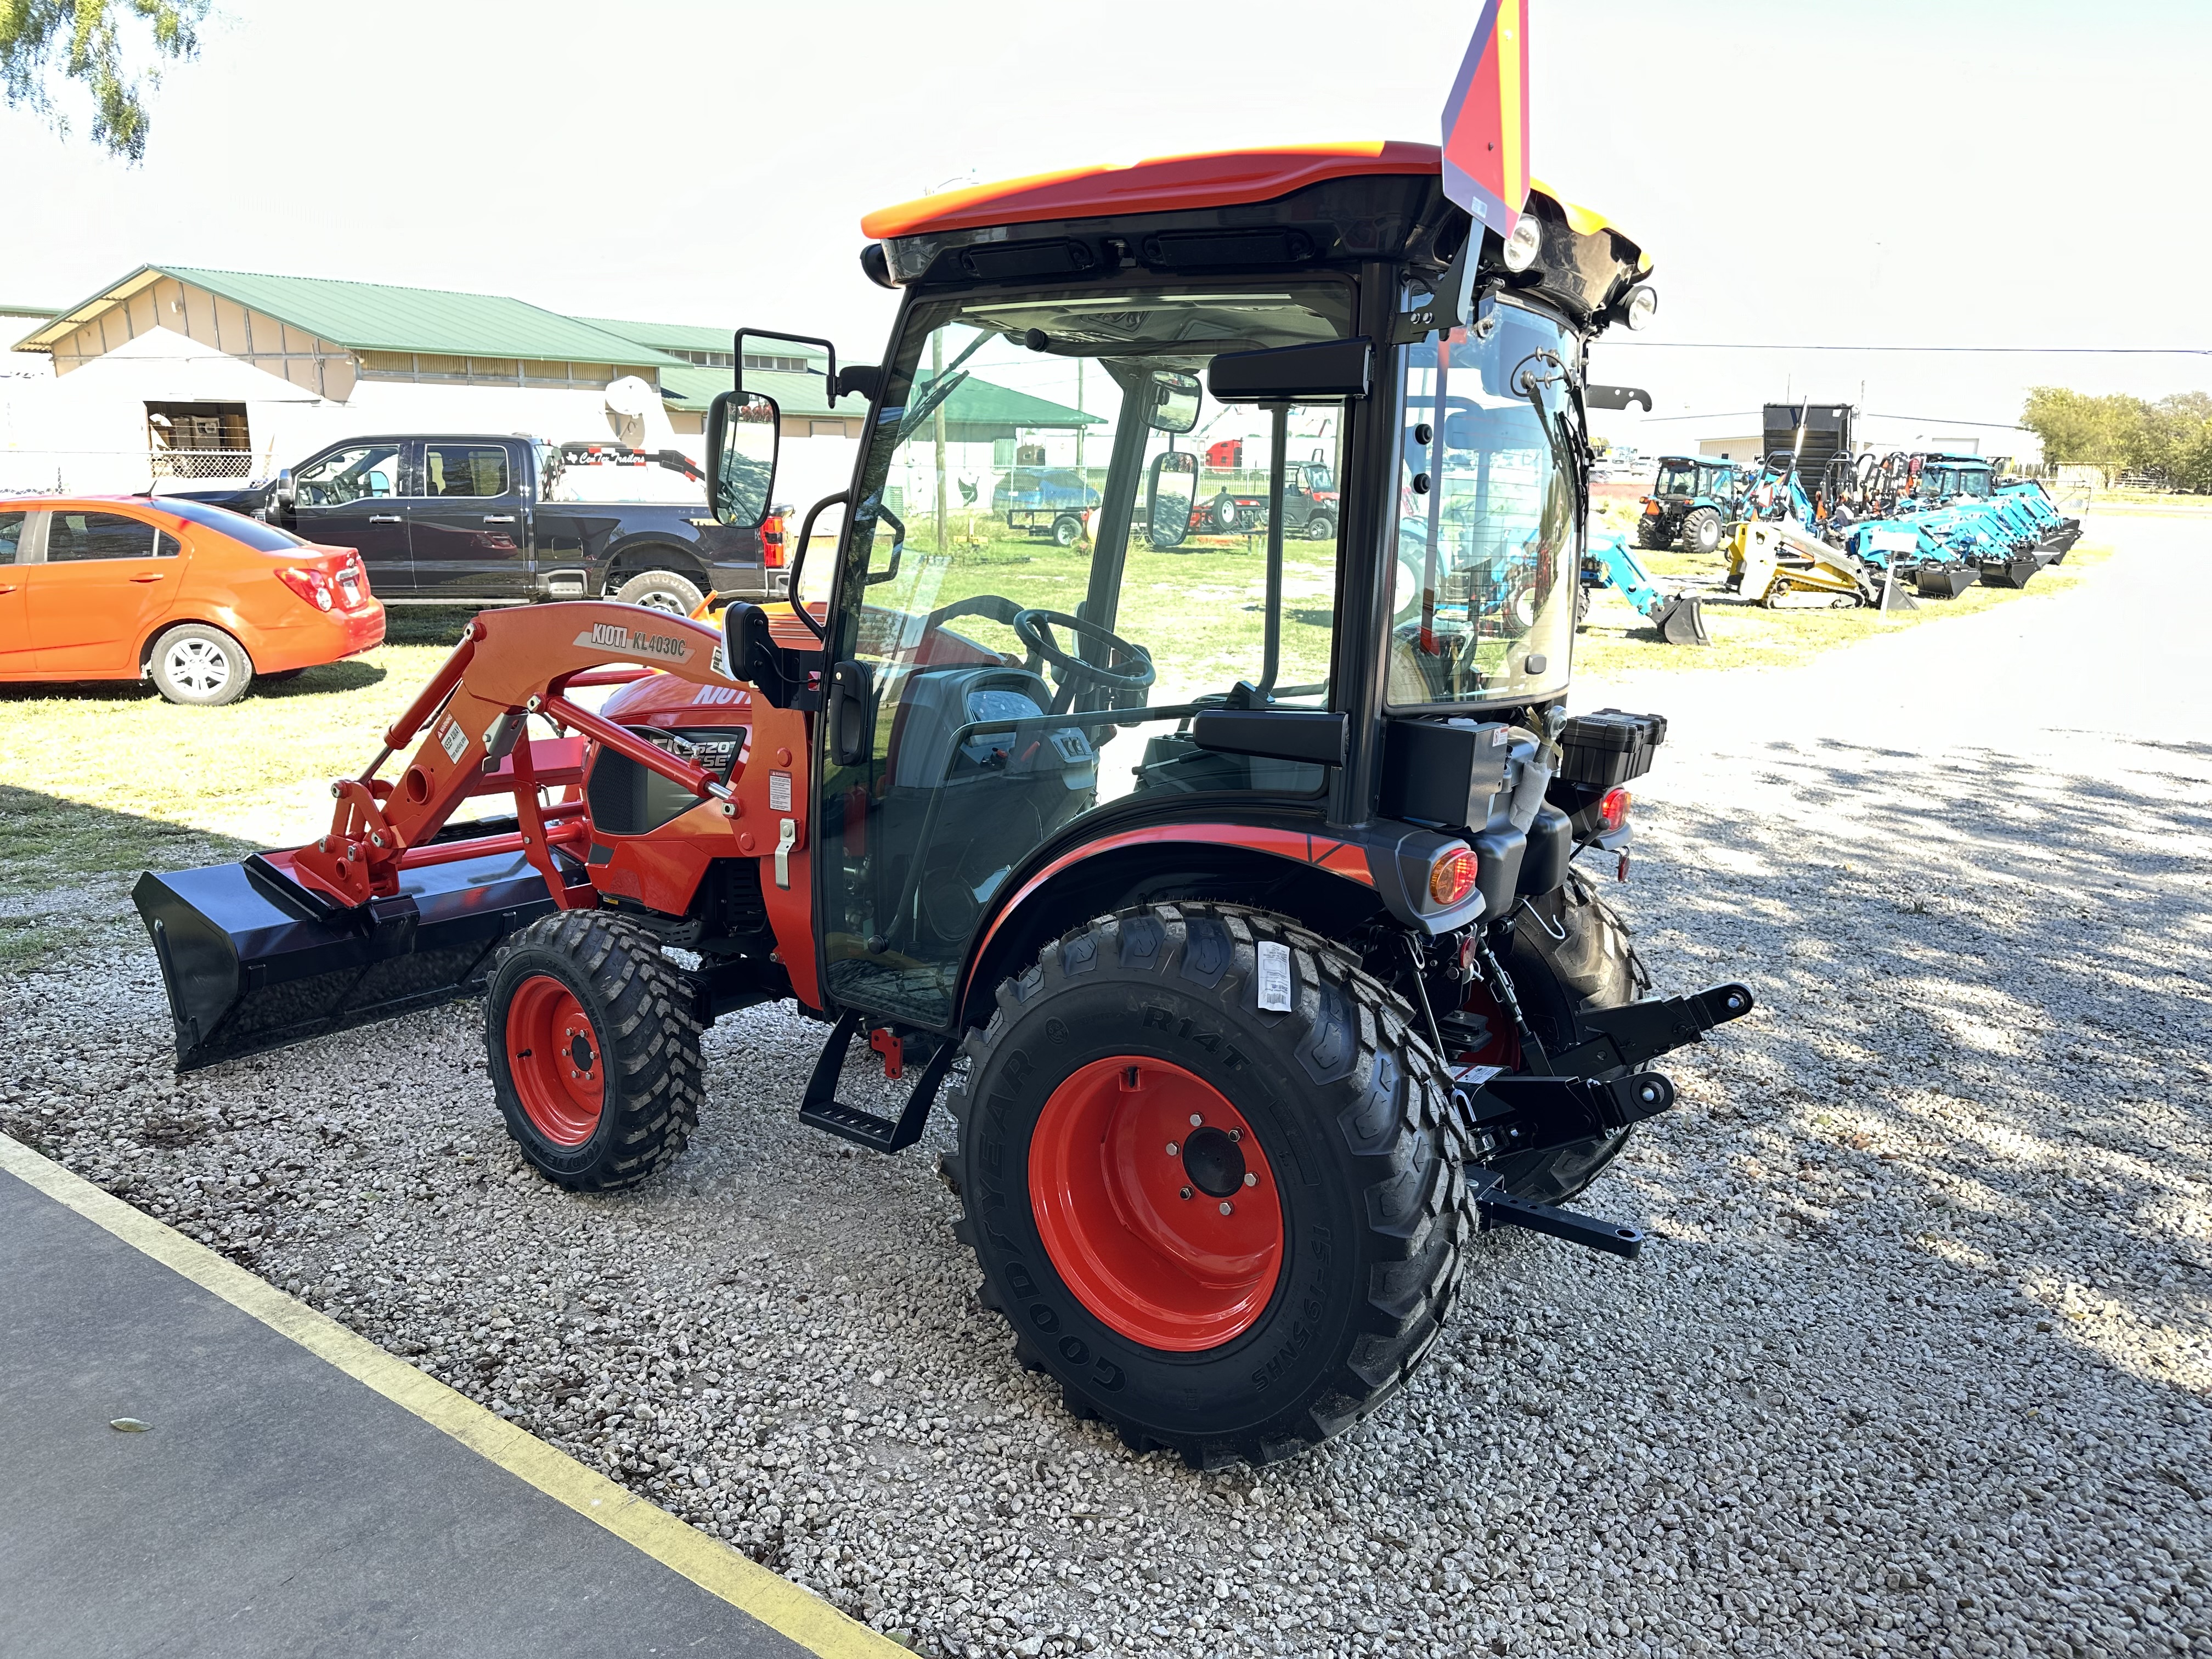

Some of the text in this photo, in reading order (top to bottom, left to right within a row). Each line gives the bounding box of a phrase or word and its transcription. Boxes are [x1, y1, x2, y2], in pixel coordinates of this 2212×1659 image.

[611, 453, 645, 463] Trailers
[591, 622, 686, 657] KIOTI KL4030C
[450, 724, 461, 741] AWAY
[702, 755, 727, 767] SE
[1141, 1005, 1253, 1069] R14T
[528, 1138, 601, 1170] GOODYEAR
[978, 1048, 1127, 1393] GOODYEAR
